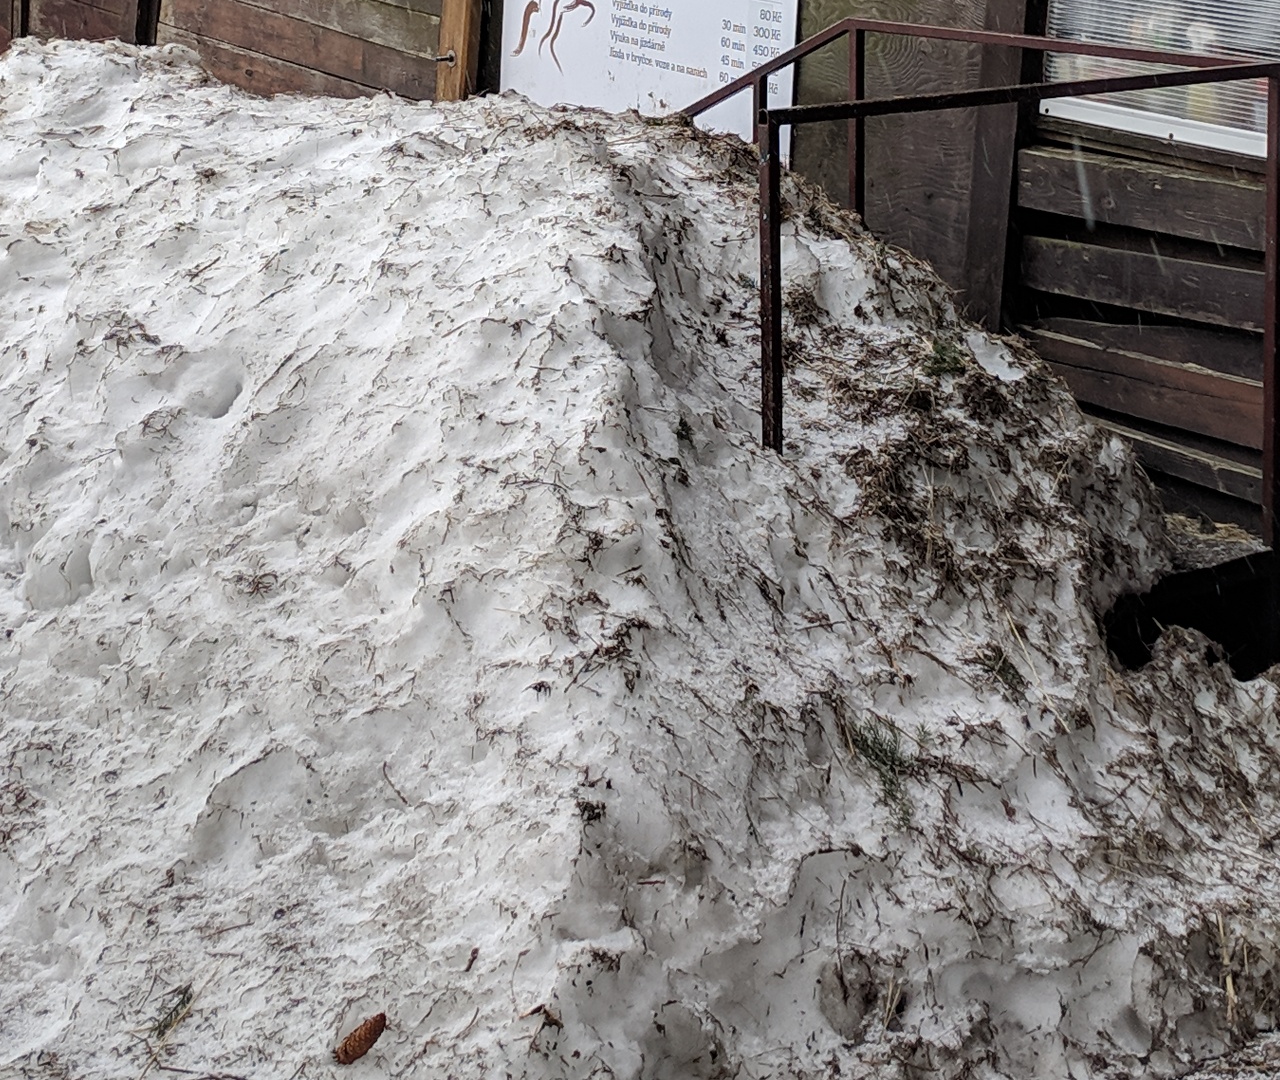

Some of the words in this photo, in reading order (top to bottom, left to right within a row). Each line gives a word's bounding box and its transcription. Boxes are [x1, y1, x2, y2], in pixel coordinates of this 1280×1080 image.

[640, 3, 647, 14] do
[722, 19, 731, 31] 30
[733, 23, 746, 34] min
[753, 26, 770, 39] 300
[771, 29, 781, 40] Kč
[760, 9, 771, 21] 80
[772, 11, 782, 23] Kč
[631, 37, 638, 46] na
[721, 55, 729, 65] 45
[731, 59, 744, 69] min
[639, 20, 647, 30] do
[721, 37, 730, 48] 60
[732, 41, 745, 51] min
[753, 45, 769, 56] 450
[671, 62, 675, 71] a
[677, 64, 684, 73] na
[719, 72, 728, 83] 60
